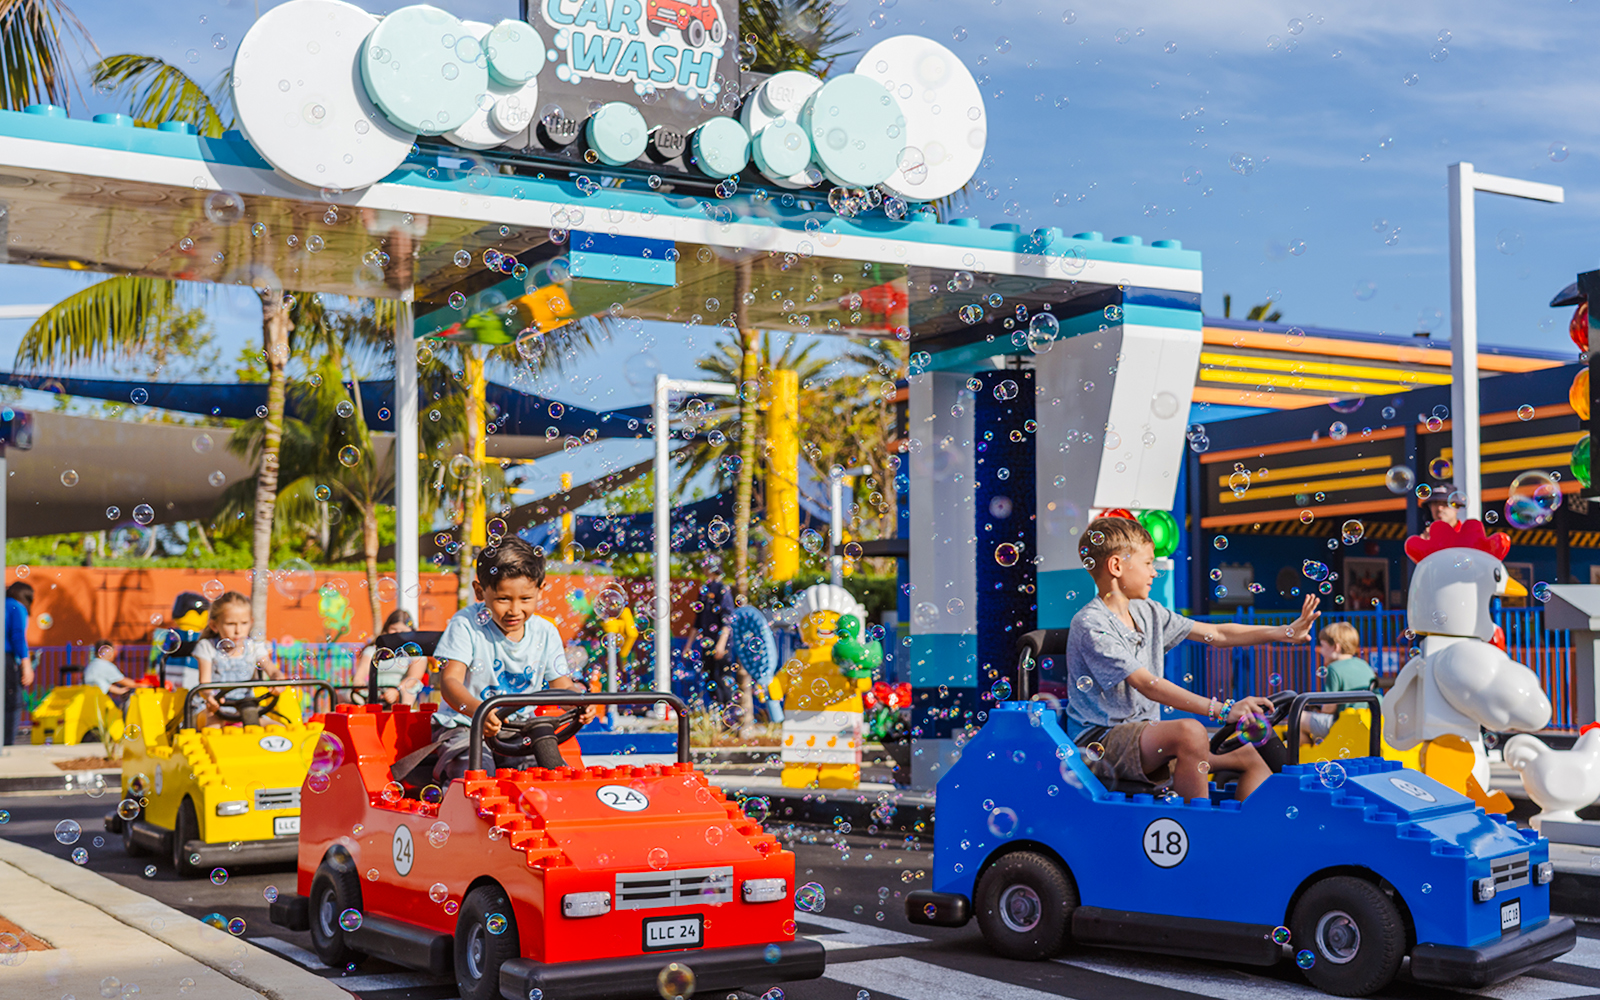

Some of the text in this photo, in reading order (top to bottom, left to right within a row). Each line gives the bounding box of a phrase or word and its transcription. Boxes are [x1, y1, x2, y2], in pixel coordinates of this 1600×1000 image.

[547, 0, 643, 35] CAR
[572, 32, 713, 88] WASH
[264, 739, 286, 749] 17
[603, 791, 643, 805] 24
[278, 820, 296, 830] LLC
[395, 836, 411, 863] 24
[1151, 830, 1182, 855] 18
[650, 924, 696, 940] LLC 24
